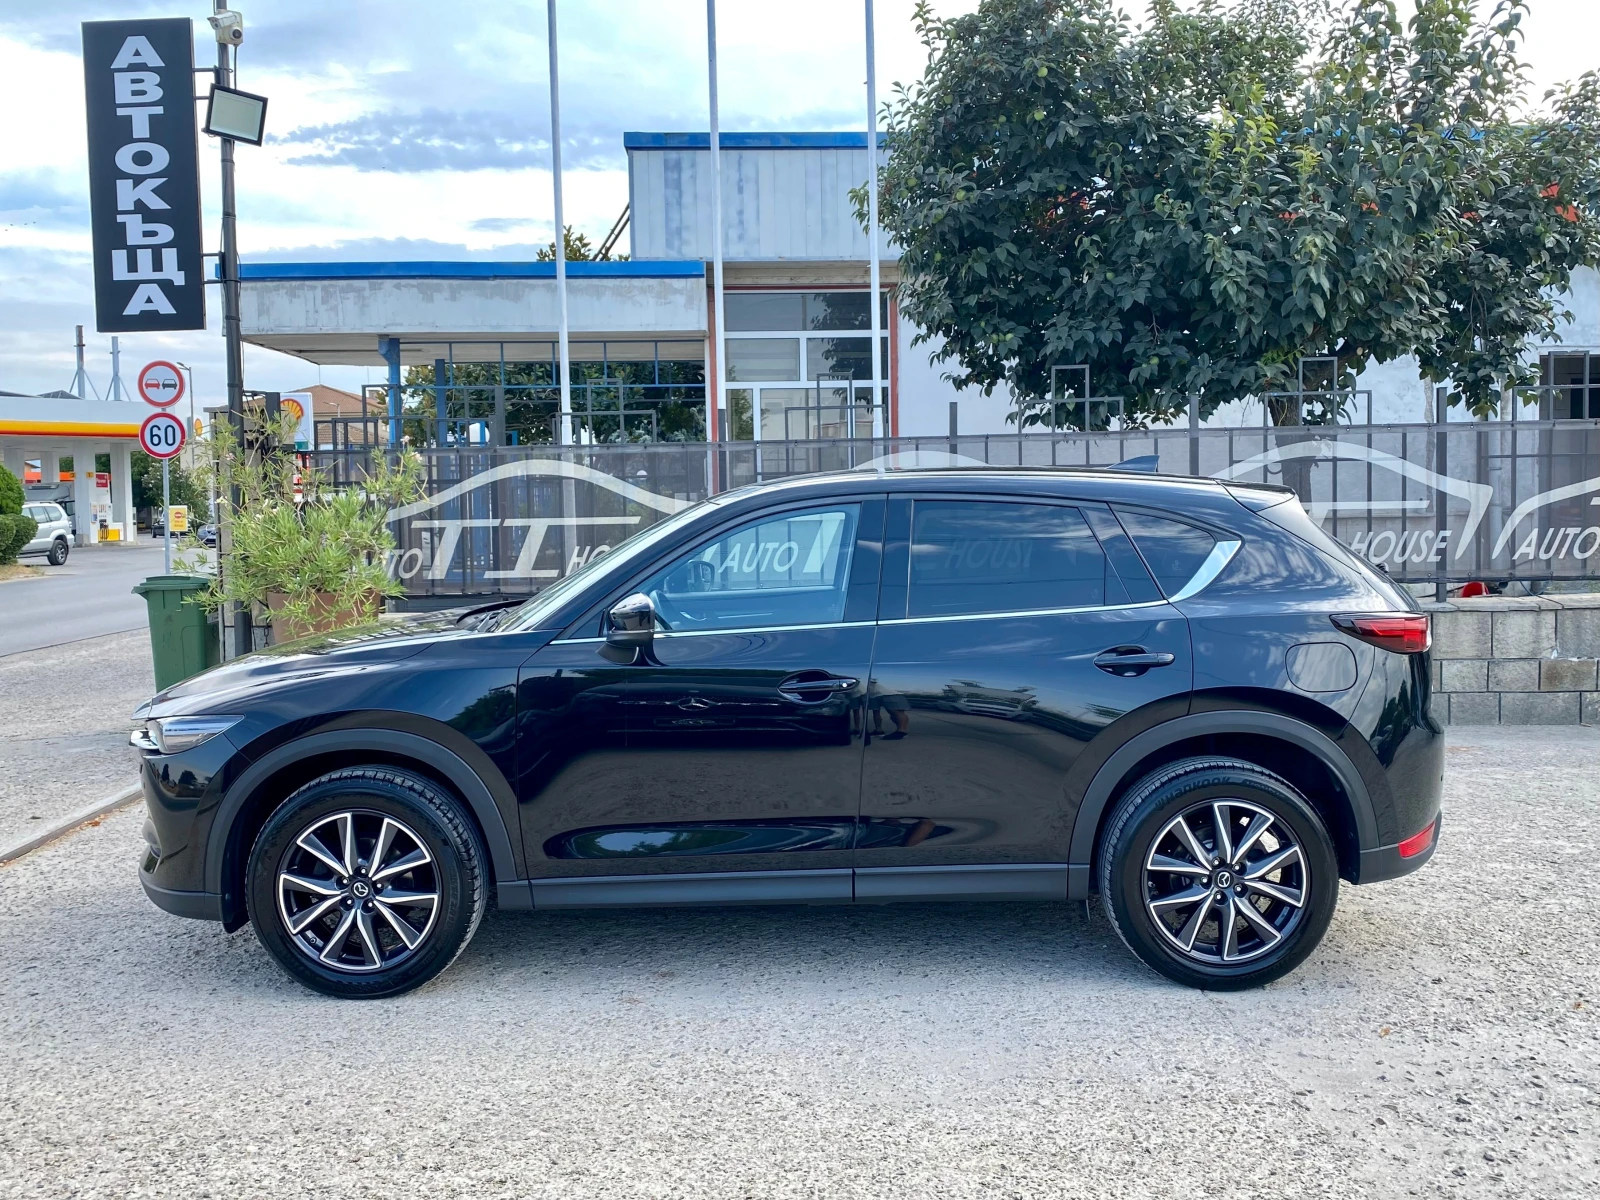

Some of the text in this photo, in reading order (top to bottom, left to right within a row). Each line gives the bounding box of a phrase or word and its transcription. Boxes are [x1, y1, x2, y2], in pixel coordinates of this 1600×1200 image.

[110, 35, 185, 316] АВТОКЪЩА
[149, 424, 177, 447] 60
[718, 541, 799, 573] AUTO
[1349, 529, 1452, 564] HOUSE
[1511, 526, 1600, 560] AUTO
